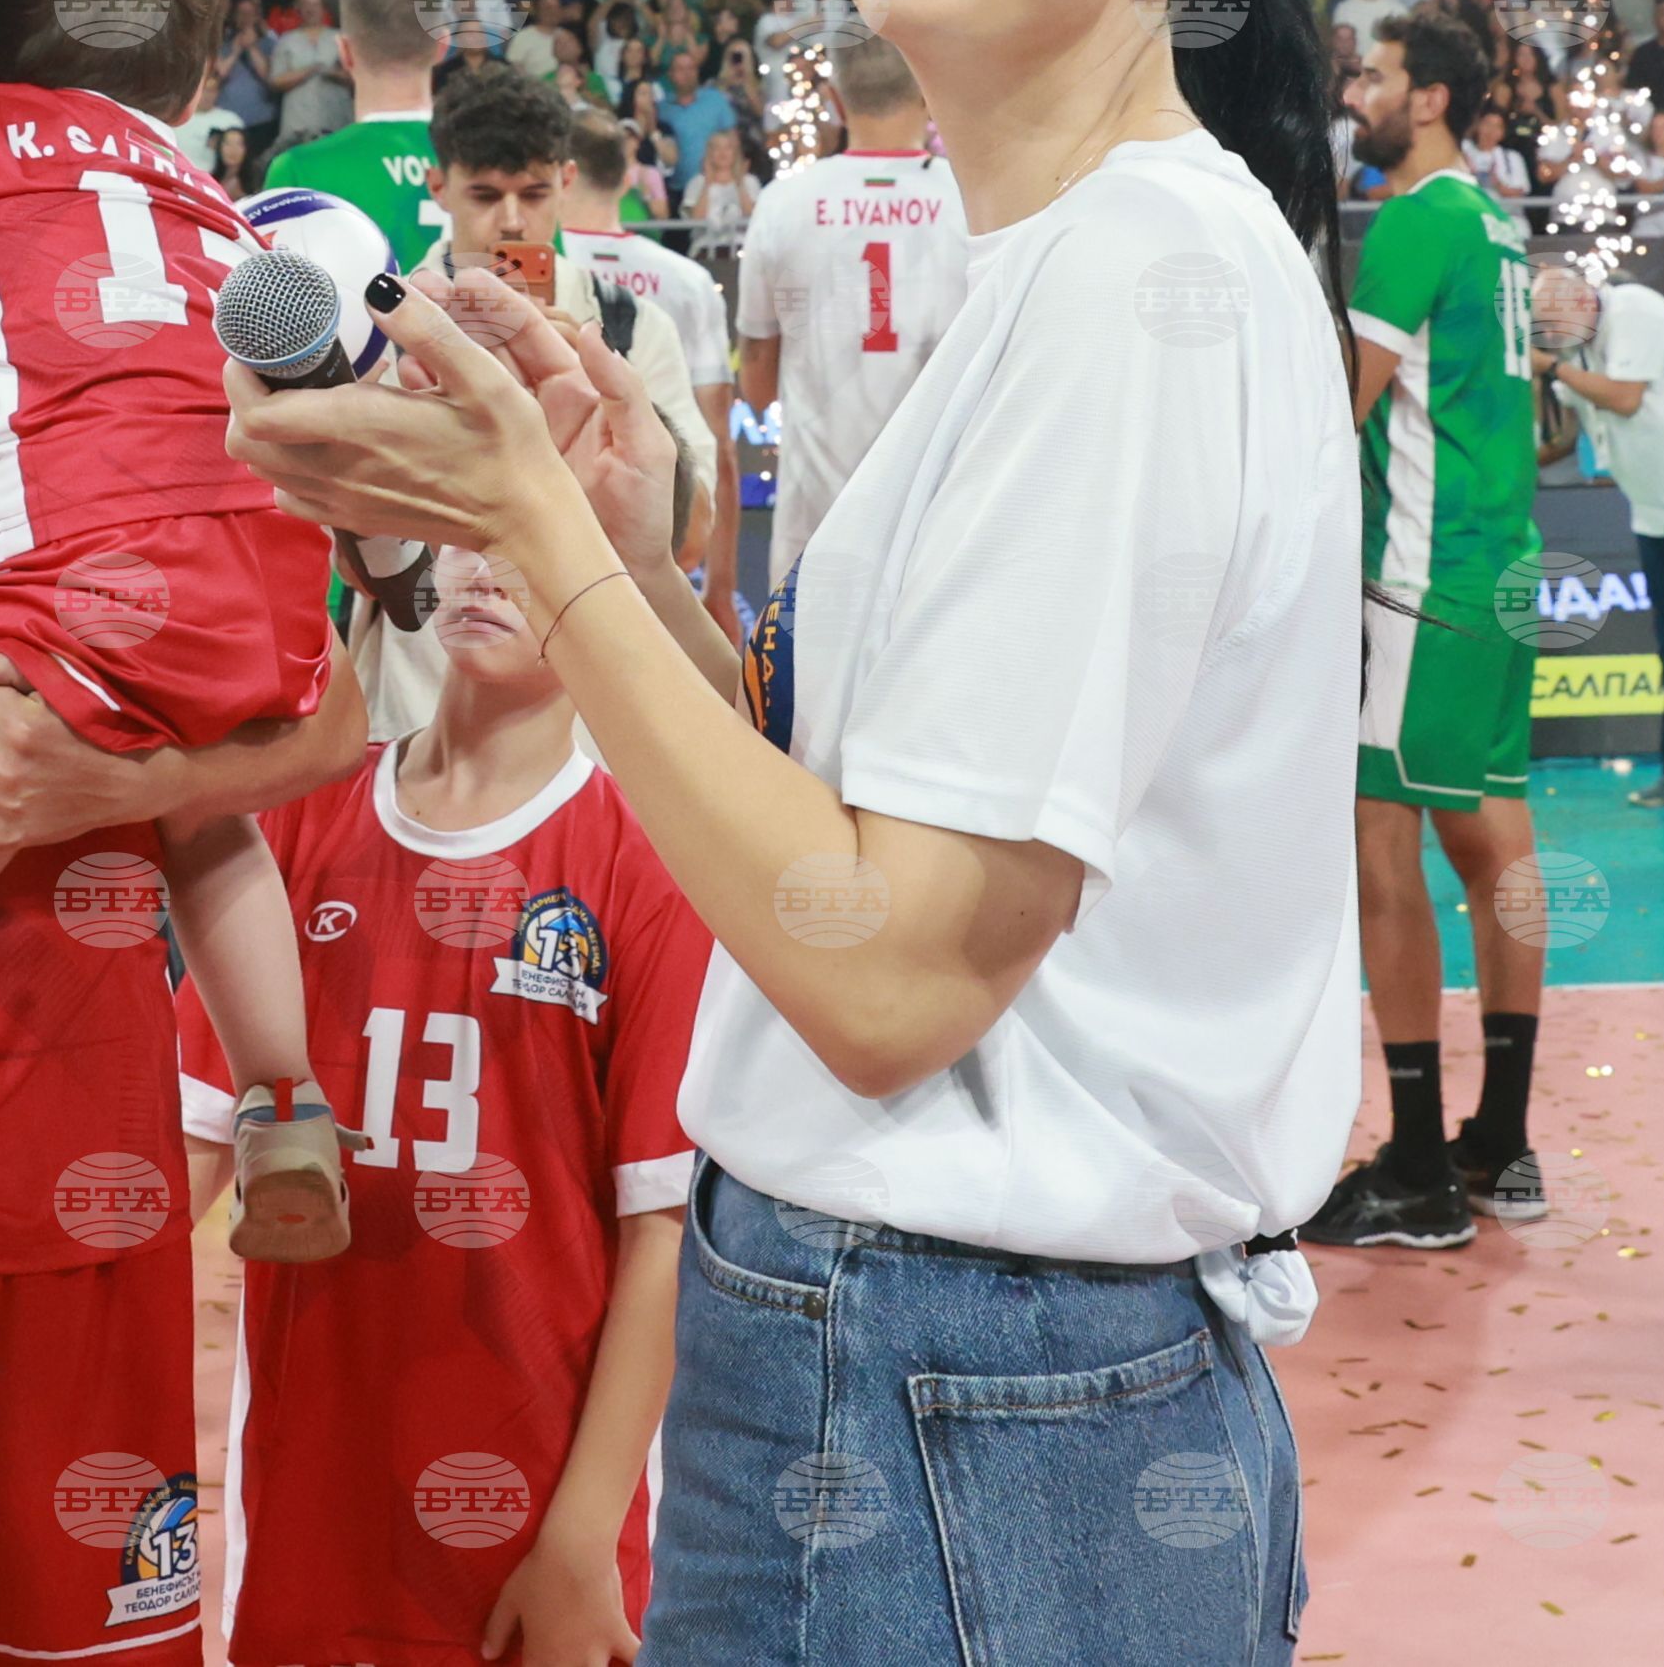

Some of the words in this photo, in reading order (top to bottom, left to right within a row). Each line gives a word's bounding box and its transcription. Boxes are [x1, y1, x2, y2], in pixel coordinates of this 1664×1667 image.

[6, 121, 56, 159] K.
[815, 199, 834, 226] E.
[843, 198, 941, 226] IVANOV
[861, 242, 899, 352] 1
[353, 1007, 482, 1174] 13
[151, 1522, 199, 1581] 13
[124, 1595, 172, 1615] ТЕОДОР
